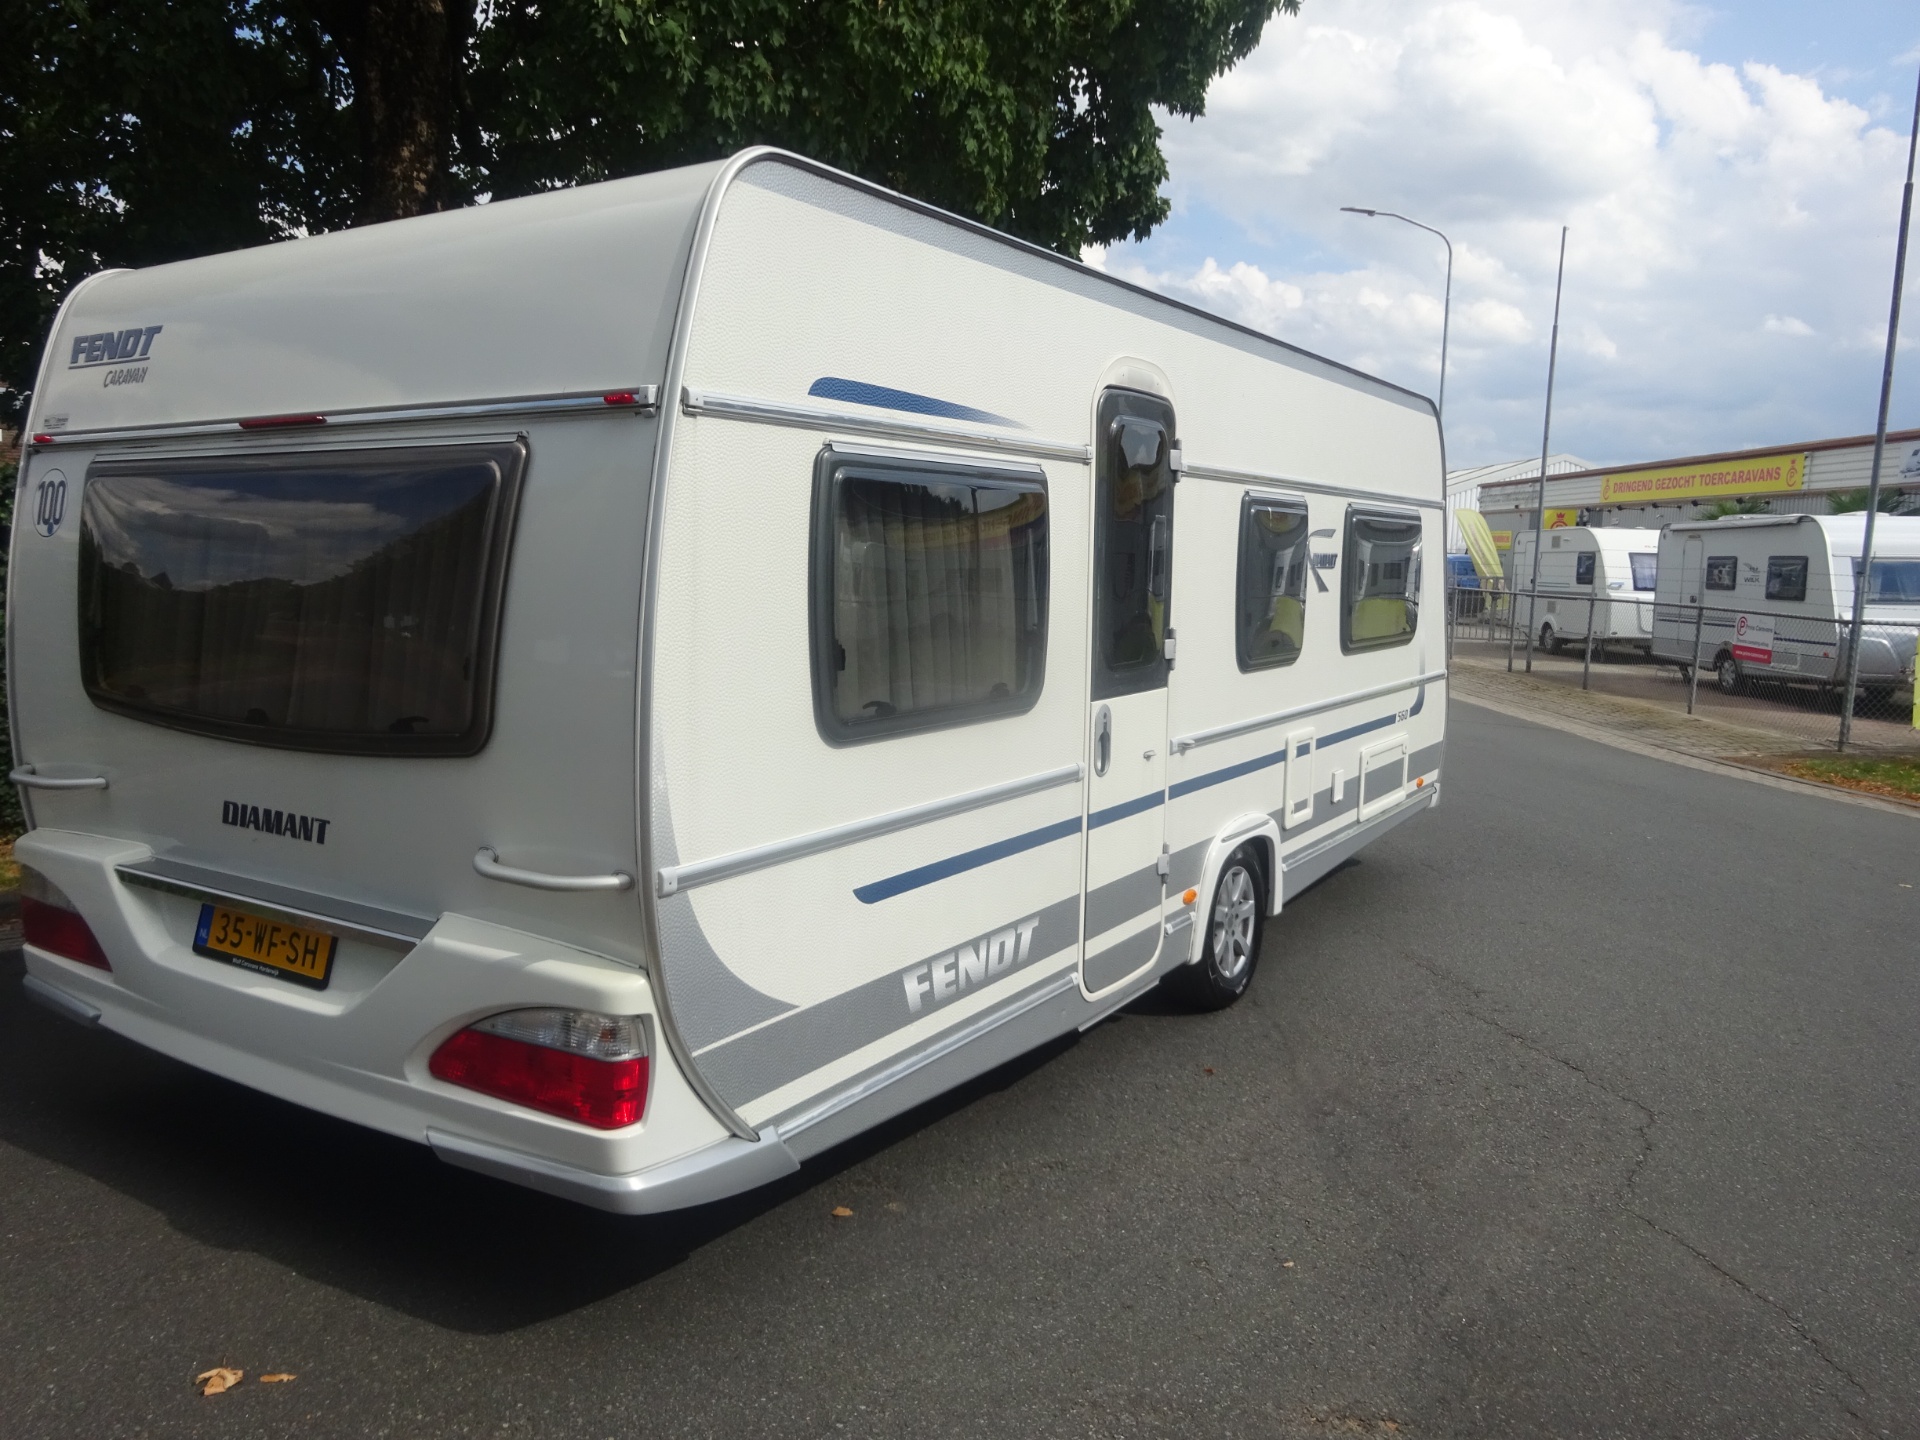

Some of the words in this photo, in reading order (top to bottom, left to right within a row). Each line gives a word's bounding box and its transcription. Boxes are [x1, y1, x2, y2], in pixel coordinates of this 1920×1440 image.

[70, 325, 163, 365] FENDT
[103, 366, 149, 388] CARAVAN
[1613, 479, 1653, 494] DRINGEND
[1655, 475, 1696, 491] GEZOCHT
[1700, 467, 1781, 486] TOERCARAVANS
[36, 480, 67, 526] 100
[222, 800, 331, 845] DIAMANT
[199, 928, 208, 938] NL
[215, 912, 320, 970] 35-WF-SH
[903, 916, 1040, 1015] FENDT
